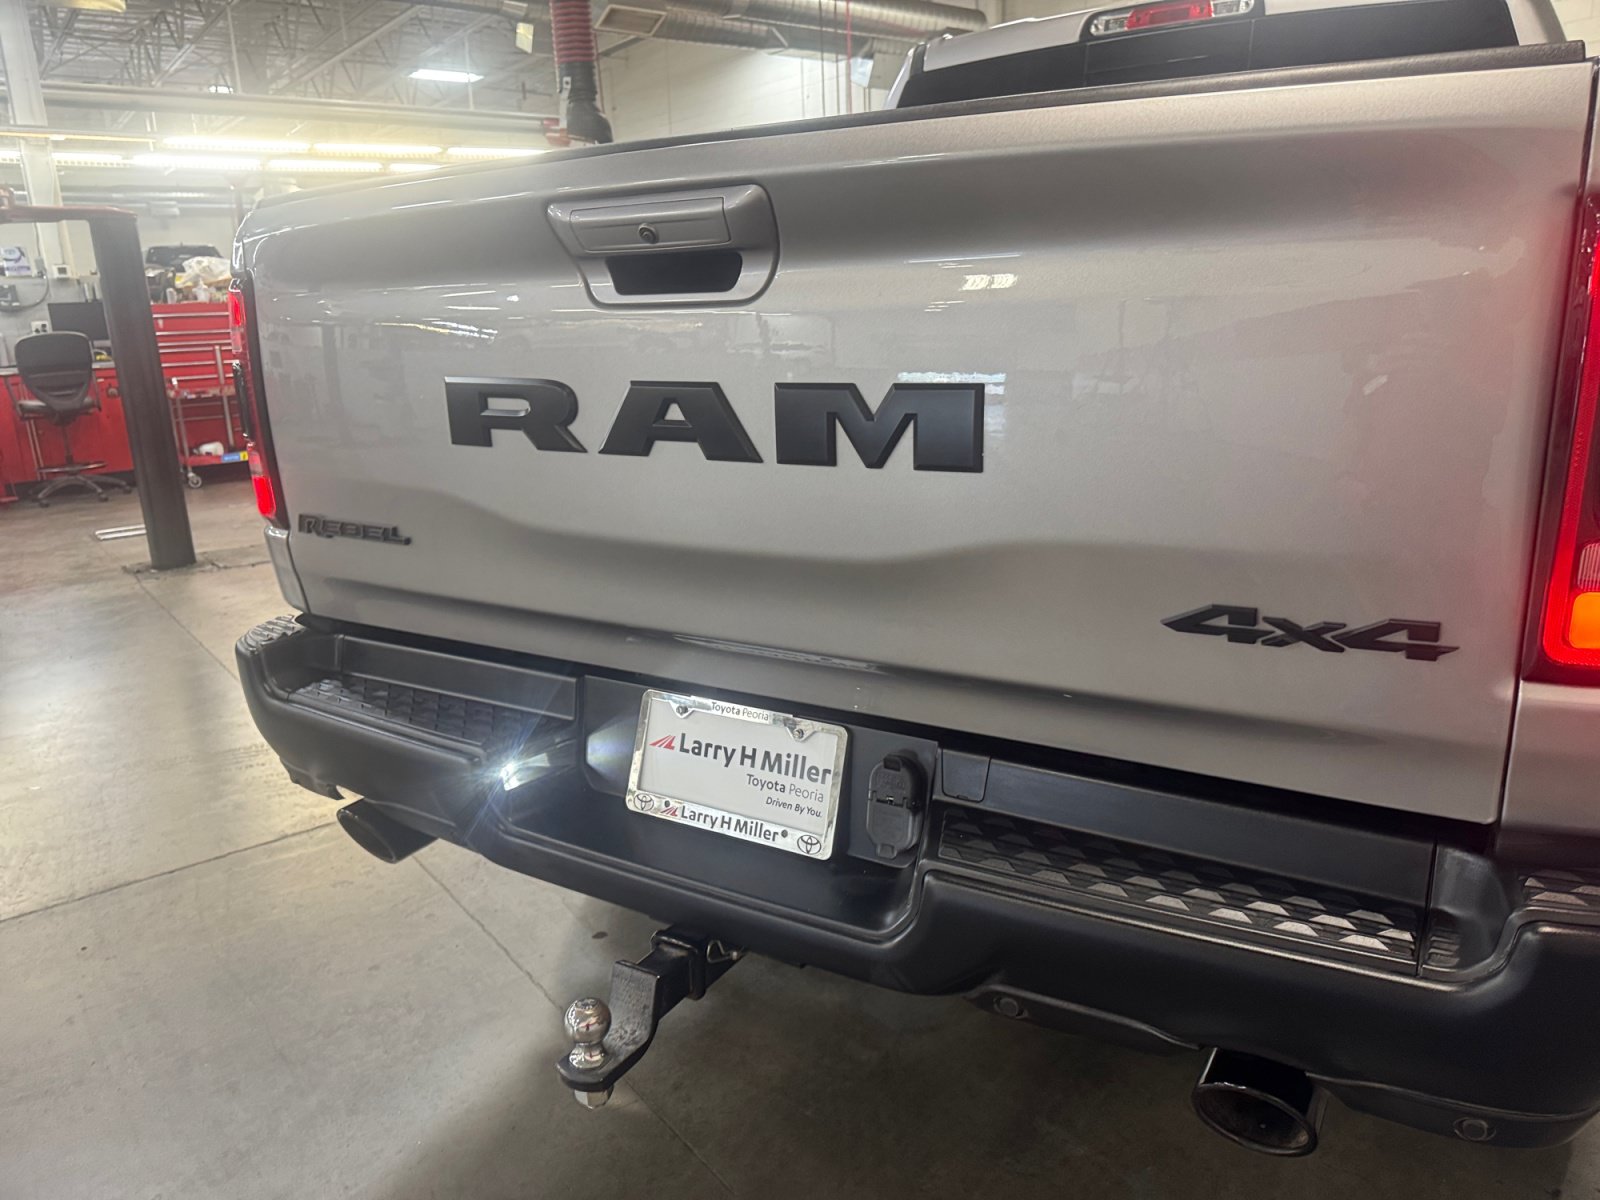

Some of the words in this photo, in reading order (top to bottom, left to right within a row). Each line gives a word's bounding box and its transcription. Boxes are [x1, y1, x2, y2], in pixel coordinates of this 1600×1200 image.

[444, 375, 985, 473] RAM
[298, 513, 412, 546] REBEL
[1160, 603, 1460, 662] 4x4
[711, 701, 741, 717] Toyota
[742, 707, 769, 721] Peoria
[679, 733, 736, 768] Larry
[739, 745, 757, 768] H
[760, 750, 832, 785] Miller
[746, 773, 786, 793] Toyota
[788, 783, 824, 802] Peoria
[680, 805, 719, 829] Larry
[720, 815, 732, 830] H
[734, 818, 779, 842] Miller
[765, 796, 793, 810] Driven
[794, 804, 806, 816] By
